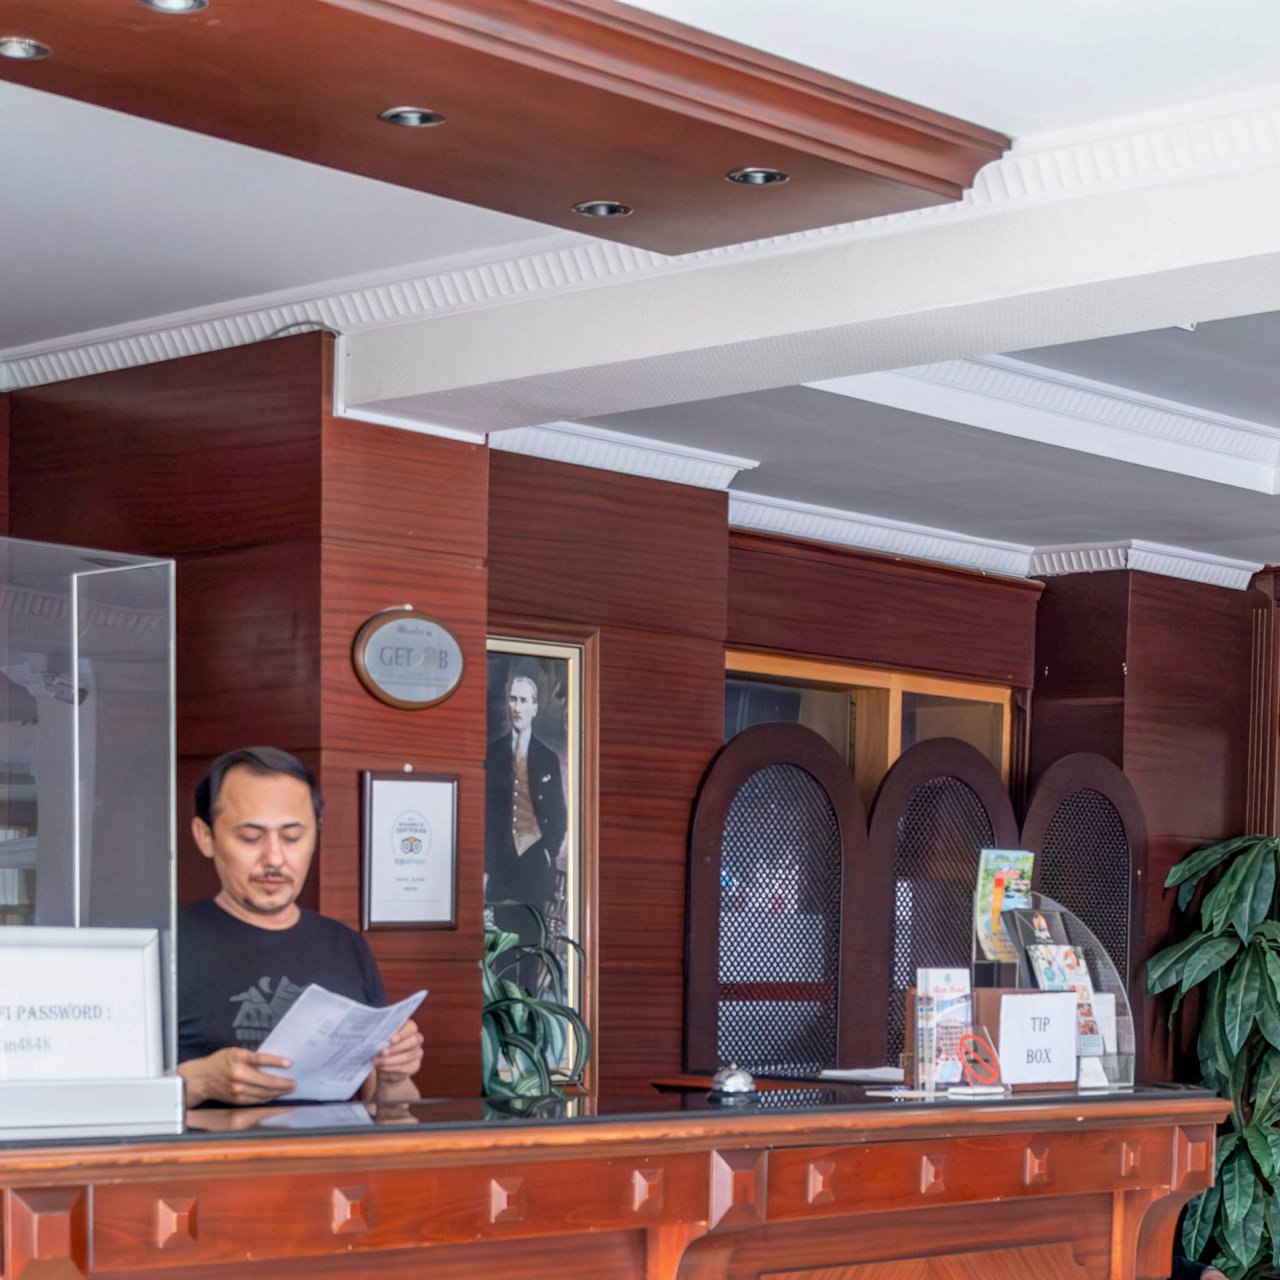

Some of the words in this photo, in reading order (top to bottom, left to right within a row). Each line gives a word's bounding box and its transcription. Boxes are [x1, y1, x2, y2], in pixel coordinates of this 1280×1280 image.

[17, 1004, 102, 1020] PASSWORD
[1031, 1016, 1050, 1032] TIP
[1026, 1049, 1051, 1064] BOX
